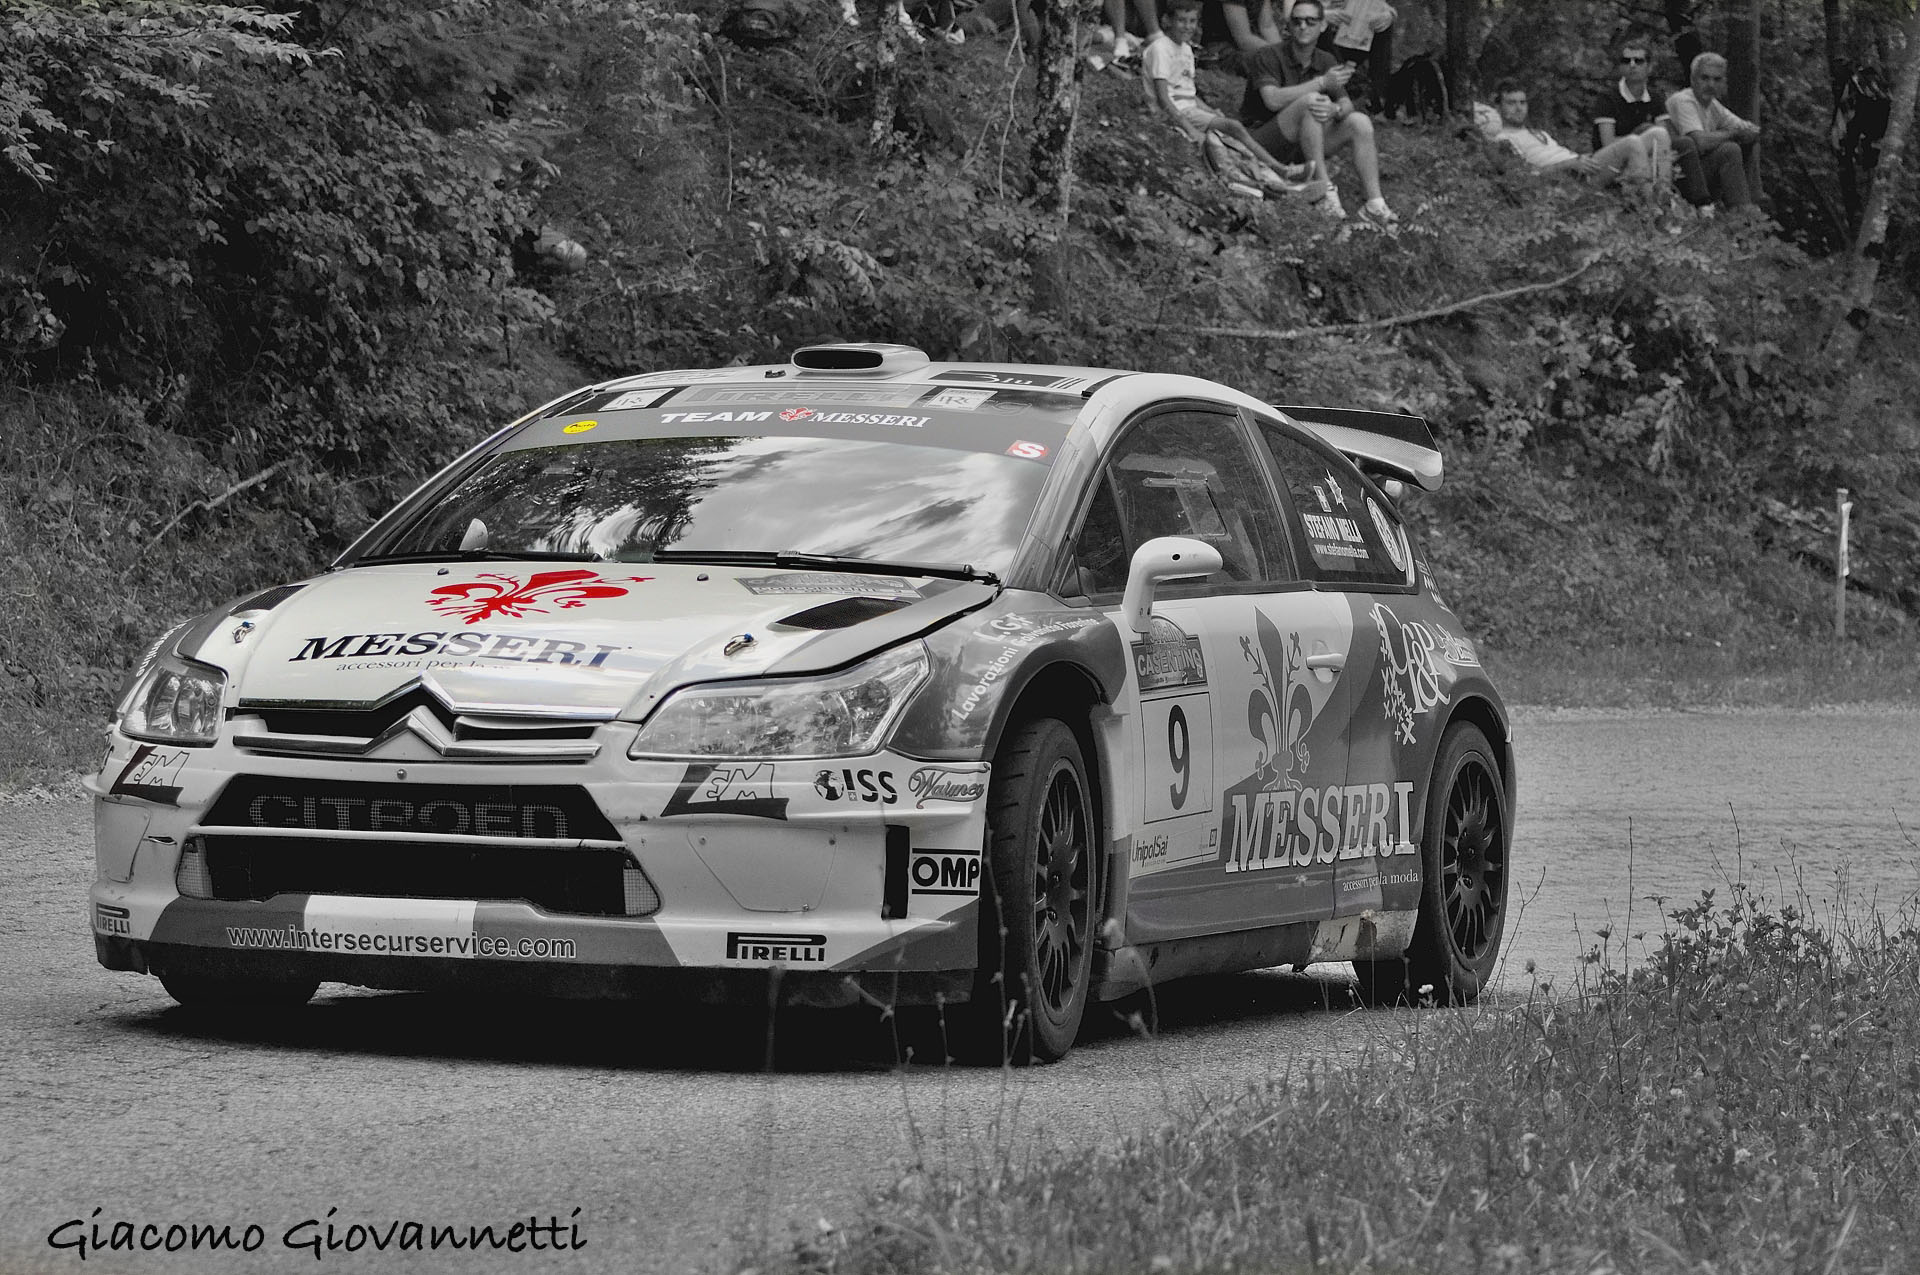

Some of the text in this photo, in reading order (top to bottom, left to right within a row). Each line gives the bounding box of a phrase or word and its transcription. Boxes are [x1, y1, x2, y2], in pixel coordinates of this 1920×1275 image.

[660, 411, 932, 428] TEAM MESSERI
[1013, 442, 1045, 459] S
[288, 631, 623, 669] MESSERI
[336, 658, 422, 671] accessori
[426, 659, 464, 671] per
[1137, 647, 1203, 677] CASENTINO
[952, 646, 1018, 720] Lavorazioni
[1168, 704, 1191, 811] 9
[1225, 781, 1415, 873] MESSERI
[1131, 835, 1169, 868] UnipolSai
[911, 856, 980, 888] OMP
[1380, 871, 1388, 885] la
[1390, 868, 1419, 884] moda
[96, 901, 131, 935] PIRELLI
[226, 924, 576, 959] www.intersecurservice.com
[726, 932, 828, 962] PIRELLI
